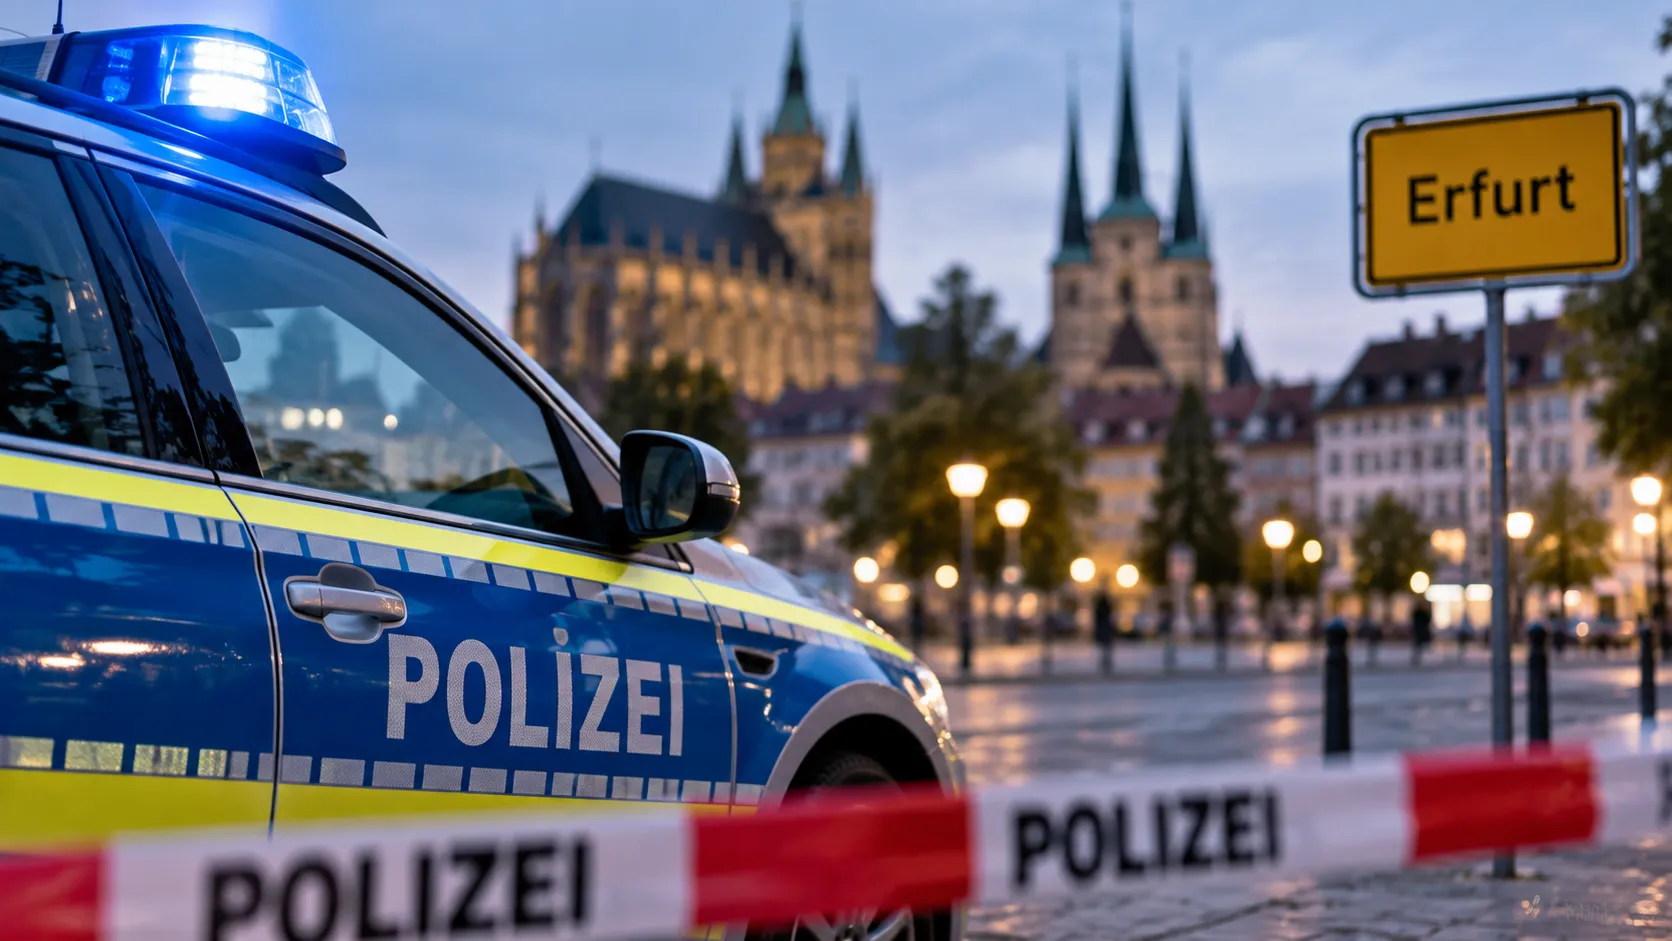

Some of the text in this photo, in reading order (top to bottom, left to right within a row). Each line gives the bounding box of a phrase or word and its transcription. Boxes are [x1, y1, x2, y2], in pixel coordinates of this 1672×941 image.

[1408, 163, 1577, 226] Erfurt
[386, 633, 684, 756] POLIZEI
[206, 833, 592, 941] POLIZEI
[1013, 787, 1279, 888] POLIZEI
